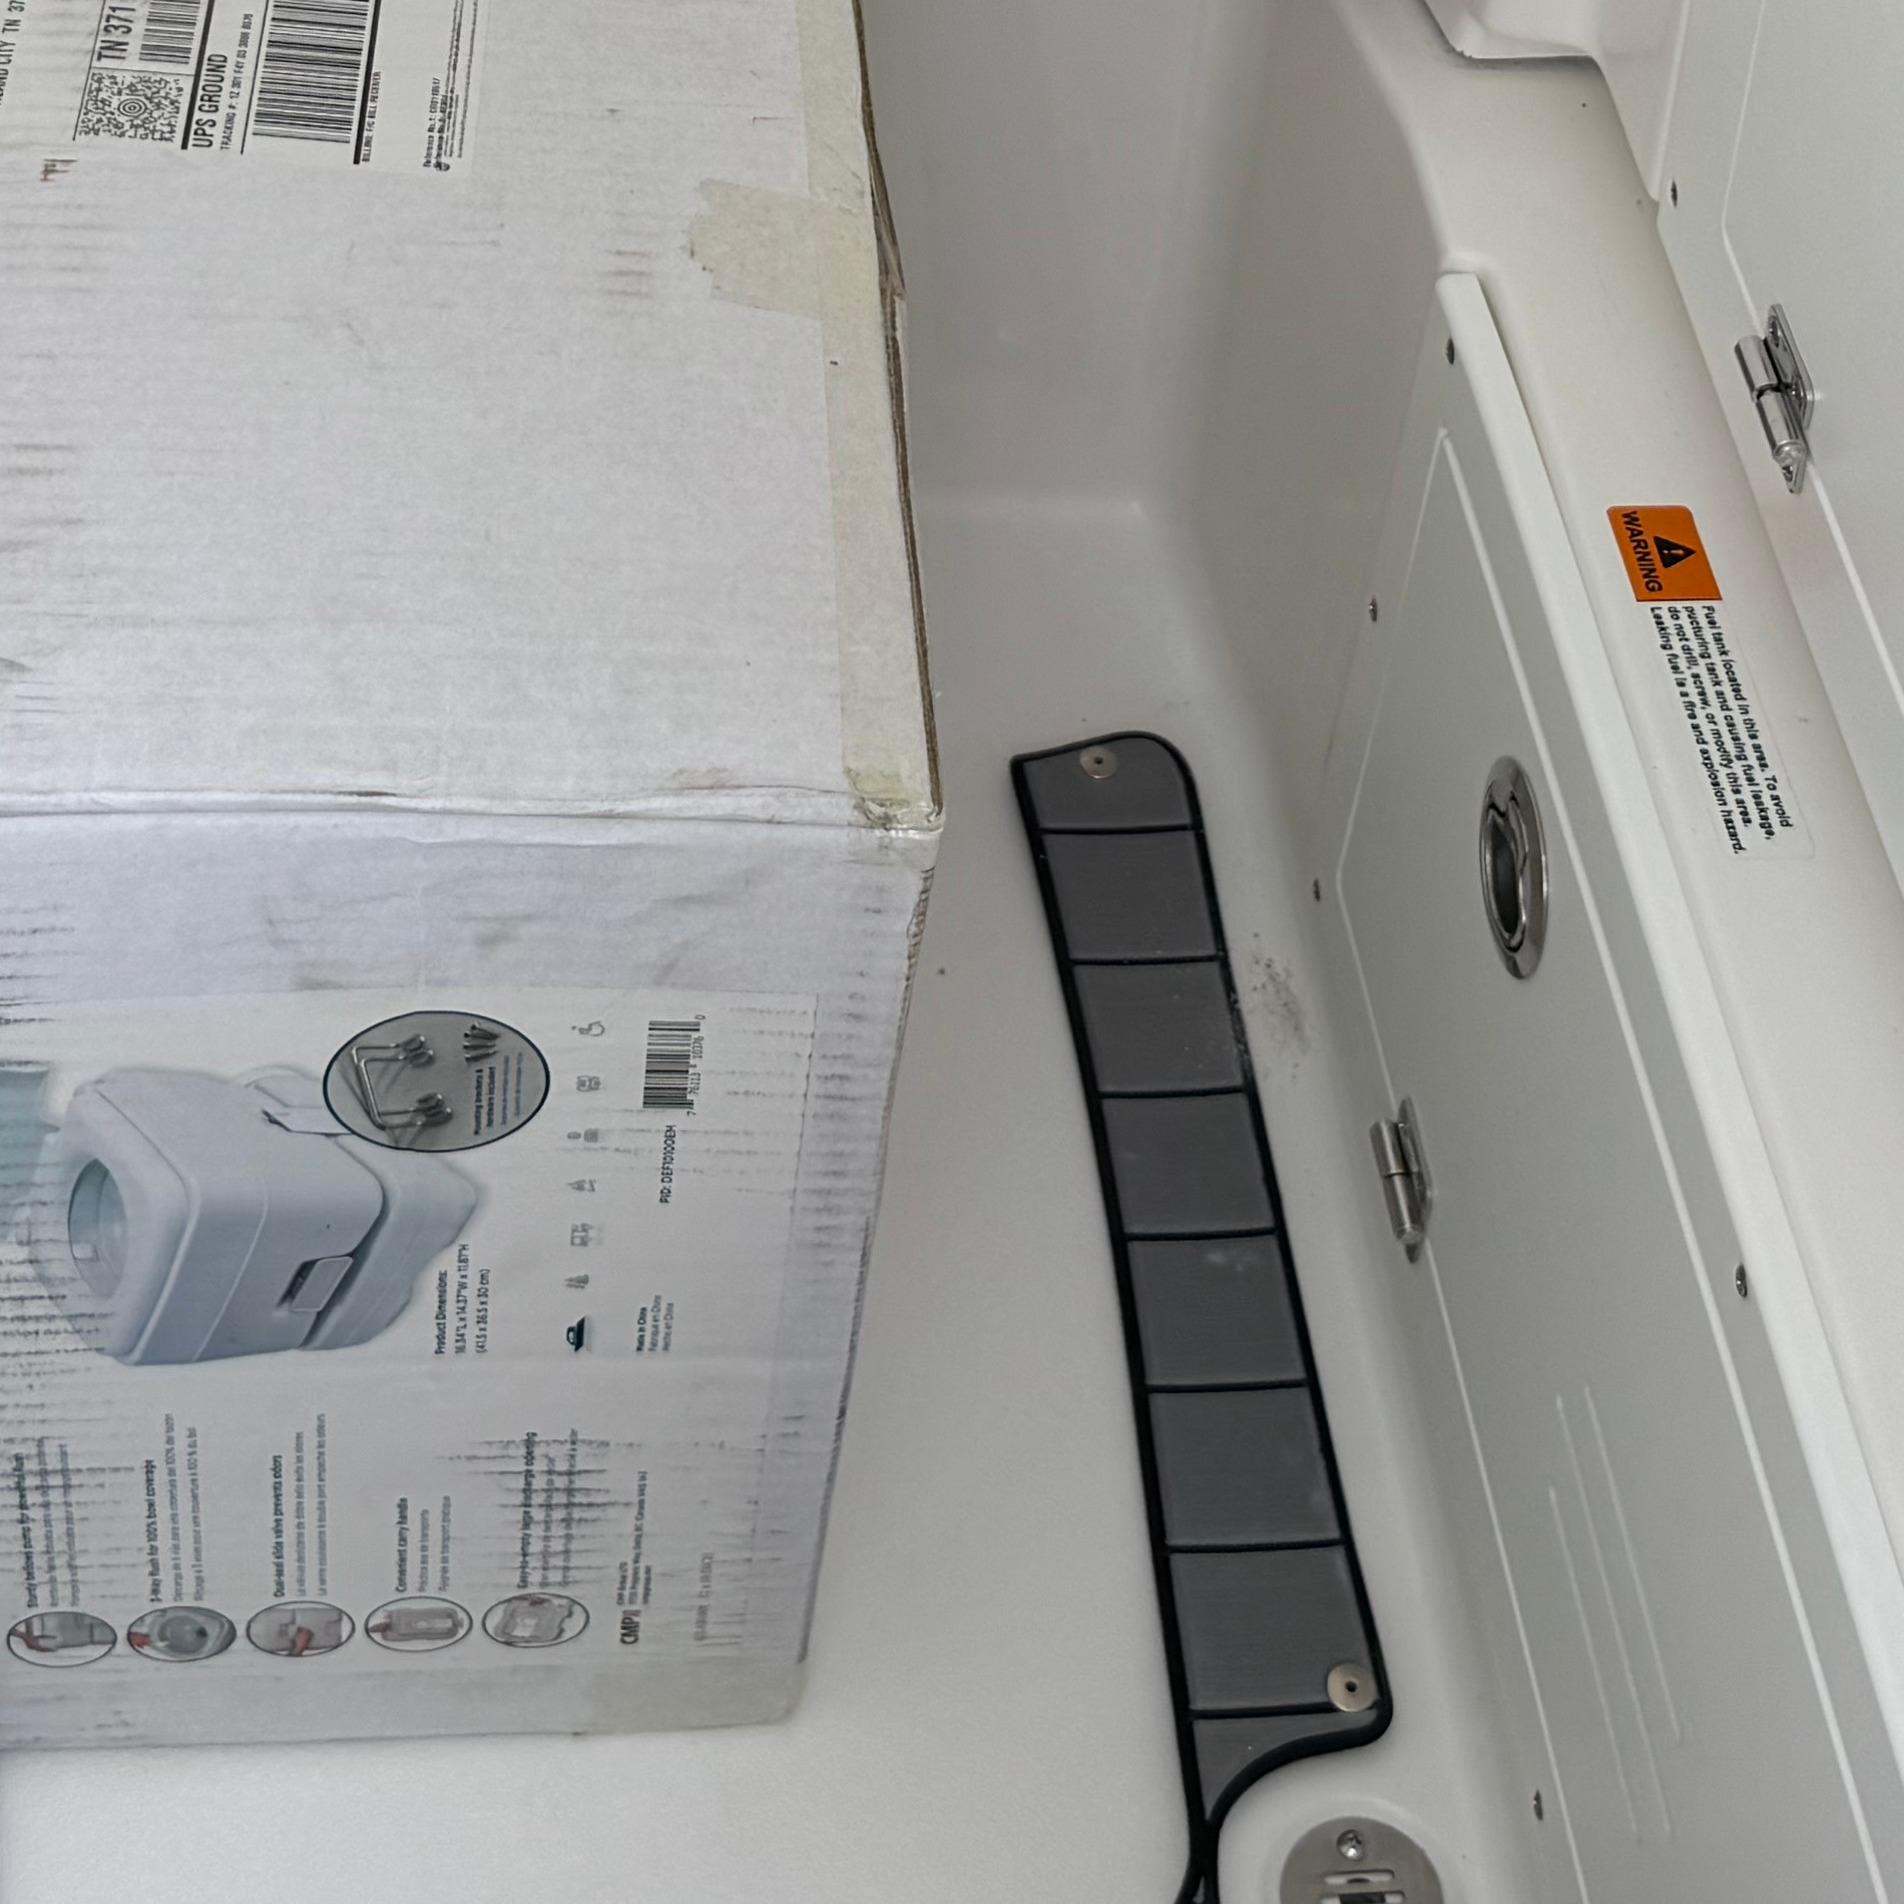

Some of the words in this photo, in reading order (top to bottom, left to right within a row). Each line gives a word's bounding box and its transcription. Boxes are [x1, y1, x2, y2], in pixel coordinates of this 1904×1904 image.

[1, 19, 22, 34] TN
[97, 39, 129, 62] TN
[197, 53, 228, 114] GROUND
[191, 118, 218, 149] UPS
[1621, 509, 1663, 595] WARNING
[1668, 607, 1680, 620] do
[1702, 606, 1721, 630] Fuel
[1651, 607, 1673, 650] Leaking
[1673, 624, 1690, 642] not
[1712, 632, 1730, 656] tank
[1666, 654, 1683, 674] fuel
[1706, 662, 1723, 687] tank
[1675, 678, 1686, 688] is
[1721, 659, 1747, 701] located
[1683, 701, 1697, 720] fire
[1716, 690, 1733, 712] and
[1738, 704, 1750, 715] in
[1705, 713, 1718, 725] or
[1743, 718, 1758, 740] this
[1691, 723, 1708, 745] and
[1724, 715, 1748, 761] causing
[1710, 729, 1733, 769] modify
[1699, 748, 1727, 806] explosion
[1726, 773, 1742, 795] this
[1742, 764, 1760, 786] fuel
[1765, 775, 1777, 791] To
[1770, 795, 1793, 827] avoid
[434, 1322, 447, 1355] Product
[619, 1616, 641, 1646] CMP
